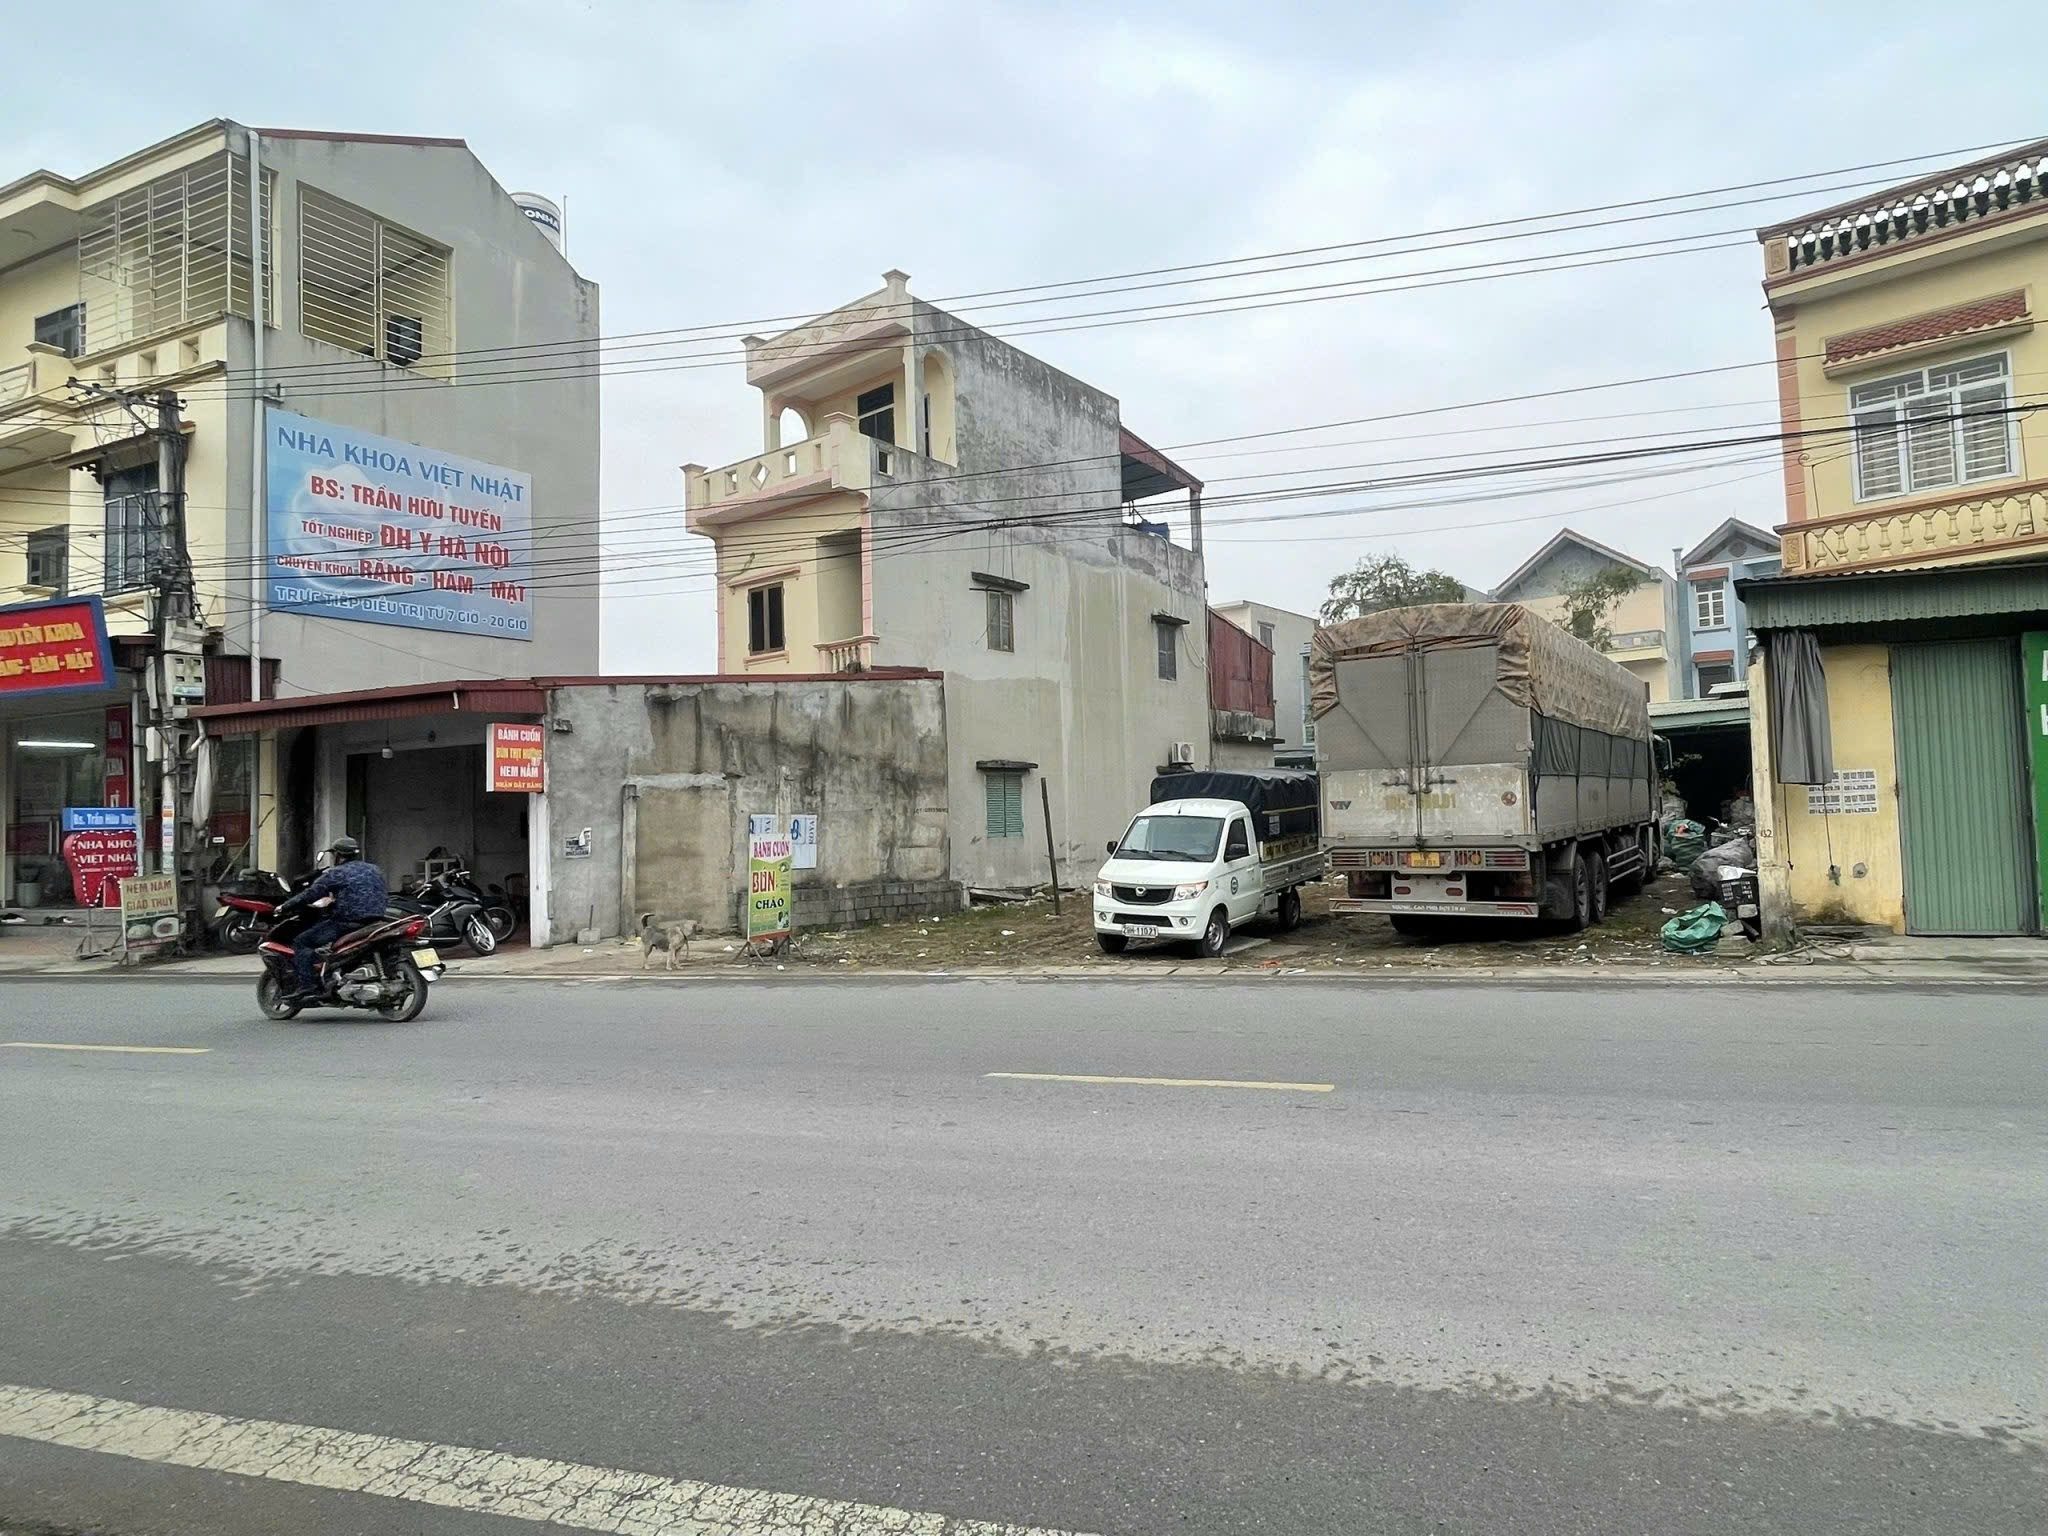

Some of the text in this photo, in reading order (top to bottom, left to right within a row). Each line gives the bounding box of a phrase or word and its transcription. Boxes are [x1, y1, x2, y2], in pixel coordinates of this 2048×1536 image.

[278, 427, 524, 503] NHA KHOA VIỆT NHẬT
[311, 476, 345, 500] BS:
[351, 484, 401, 512] TRẦN
[408, 497, 444, 519] HỮU
[302, 519, 324, 535] TỐT
[380, 524, 411, 550] ĐH
[420, 532, 432, 553] Y
[440, 535, 467, 560] HÀ
[475, 541, 509, 570] NỘI
[277, 556, 322, 571] CHUYÊN
[360, 559, 413, 585] RĂNG
[433, 570, 473, 594] HÀM
[491, 582, 526, 604] MẶT
[447, 610, 455, 621] 7
[490, 615, 504, 628] 20
[498, 727, 541, 742] BÁNH CUỐN
[500, 766, 519, 777] NEM
[77, 840, 104, 850] NHA
[753, 837, 772, 858] BÁNH
[752, 867, 775, 893] BÚN
